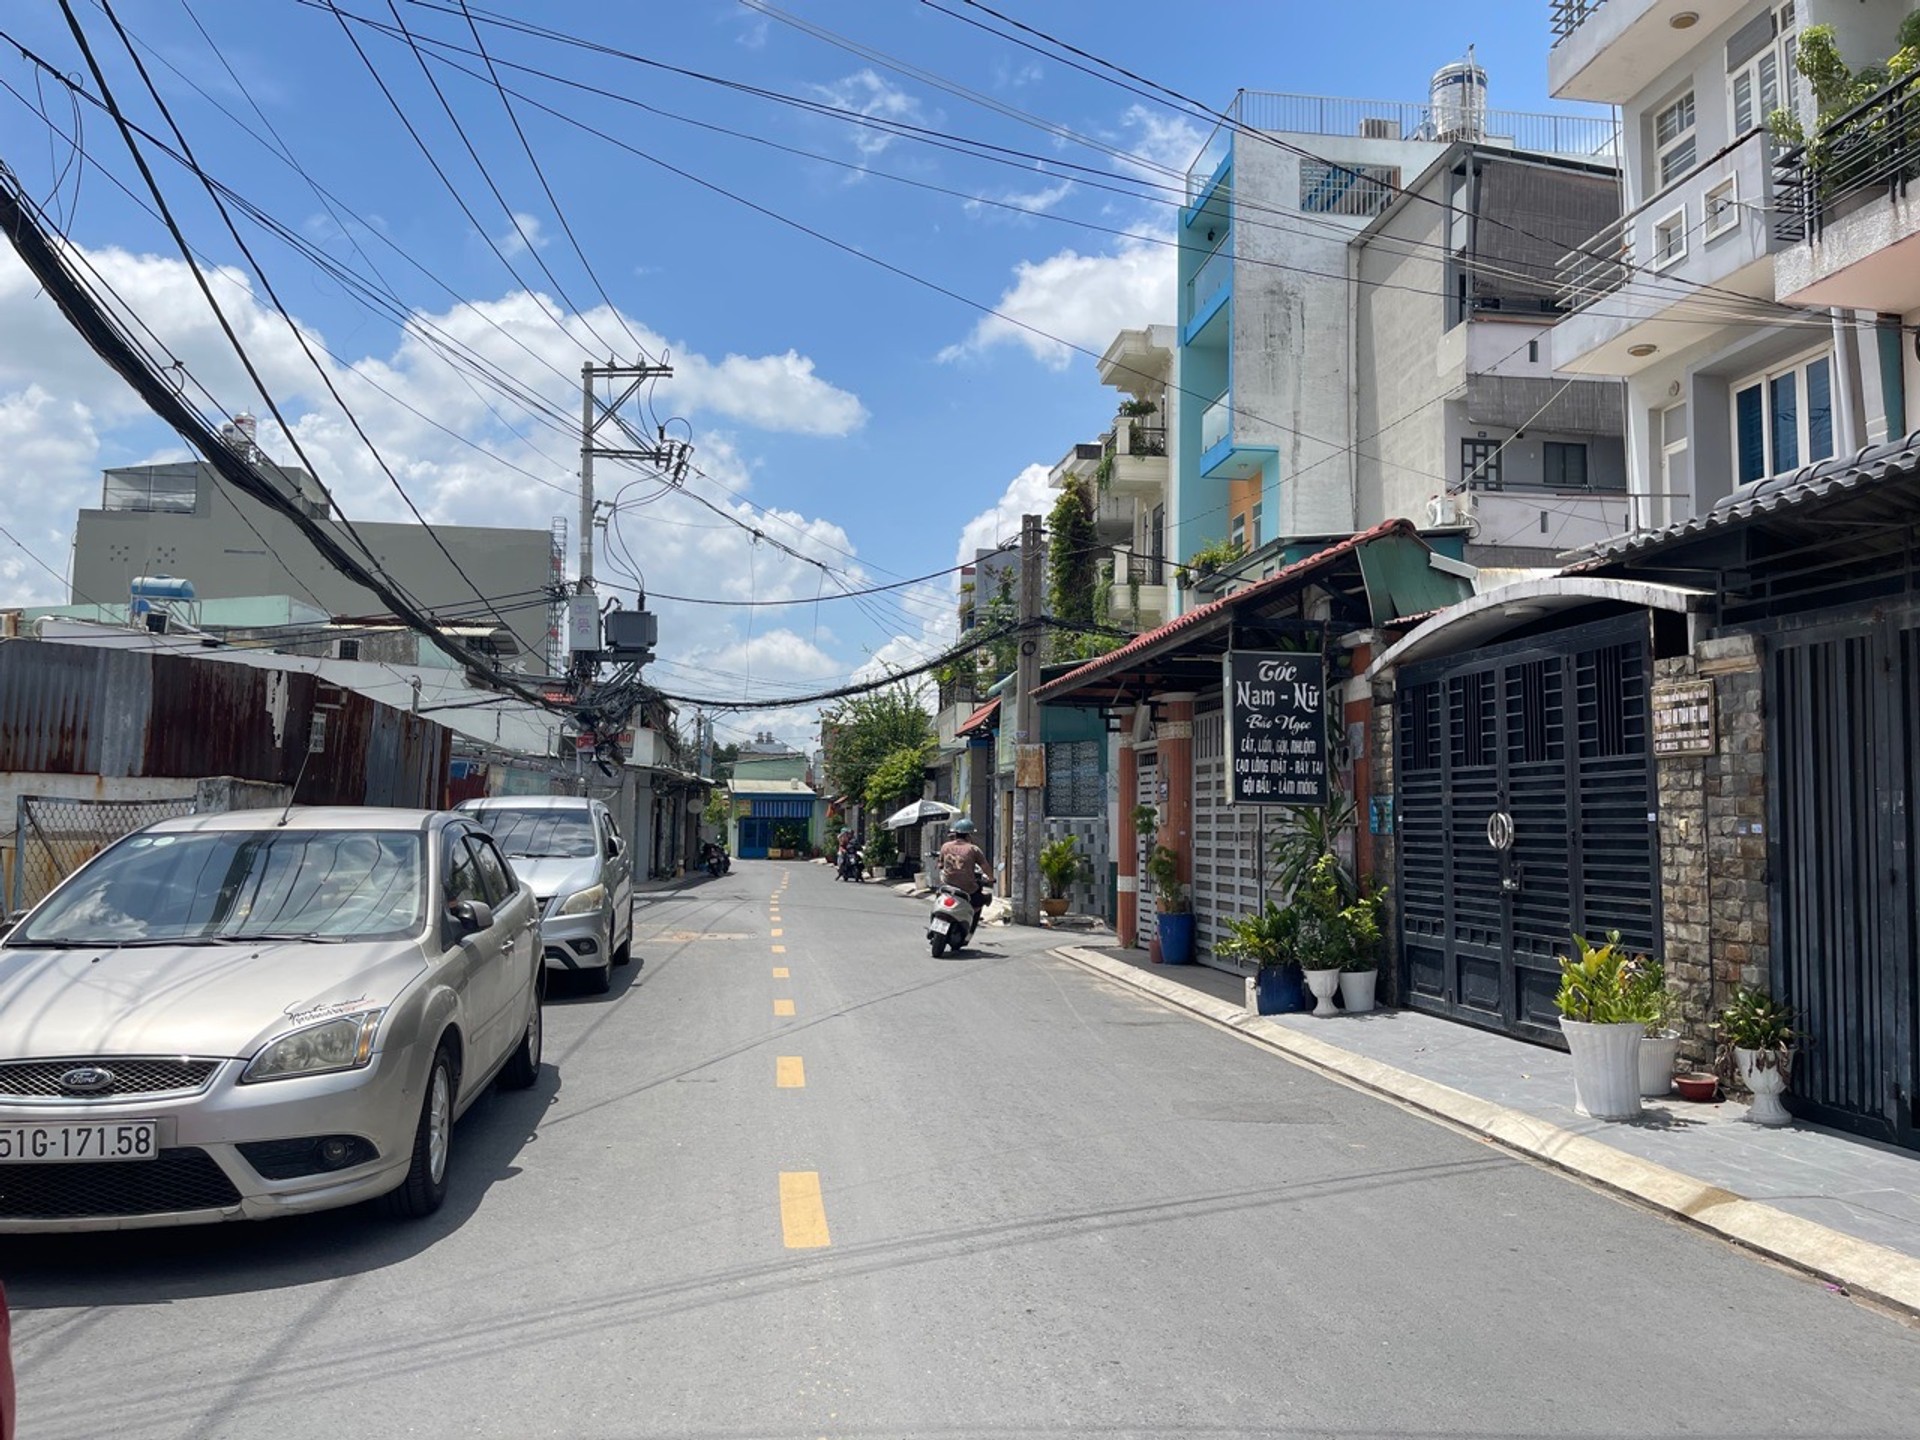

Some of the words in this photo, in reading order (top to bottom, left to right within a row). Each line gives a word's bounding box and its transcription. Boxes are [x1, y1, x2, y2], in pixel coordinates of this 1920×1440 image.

[1258, 661, 1297, 682] Tóc
[1236, 680, 1275, 711] Nam
[1293, 682, 1320, 713] Nữ
[1275, 714, 1312, 736] Ngọc
[70, 1071, 97, 1085] Ford
[0, 1126, 151, 1158] 51G-171.58
